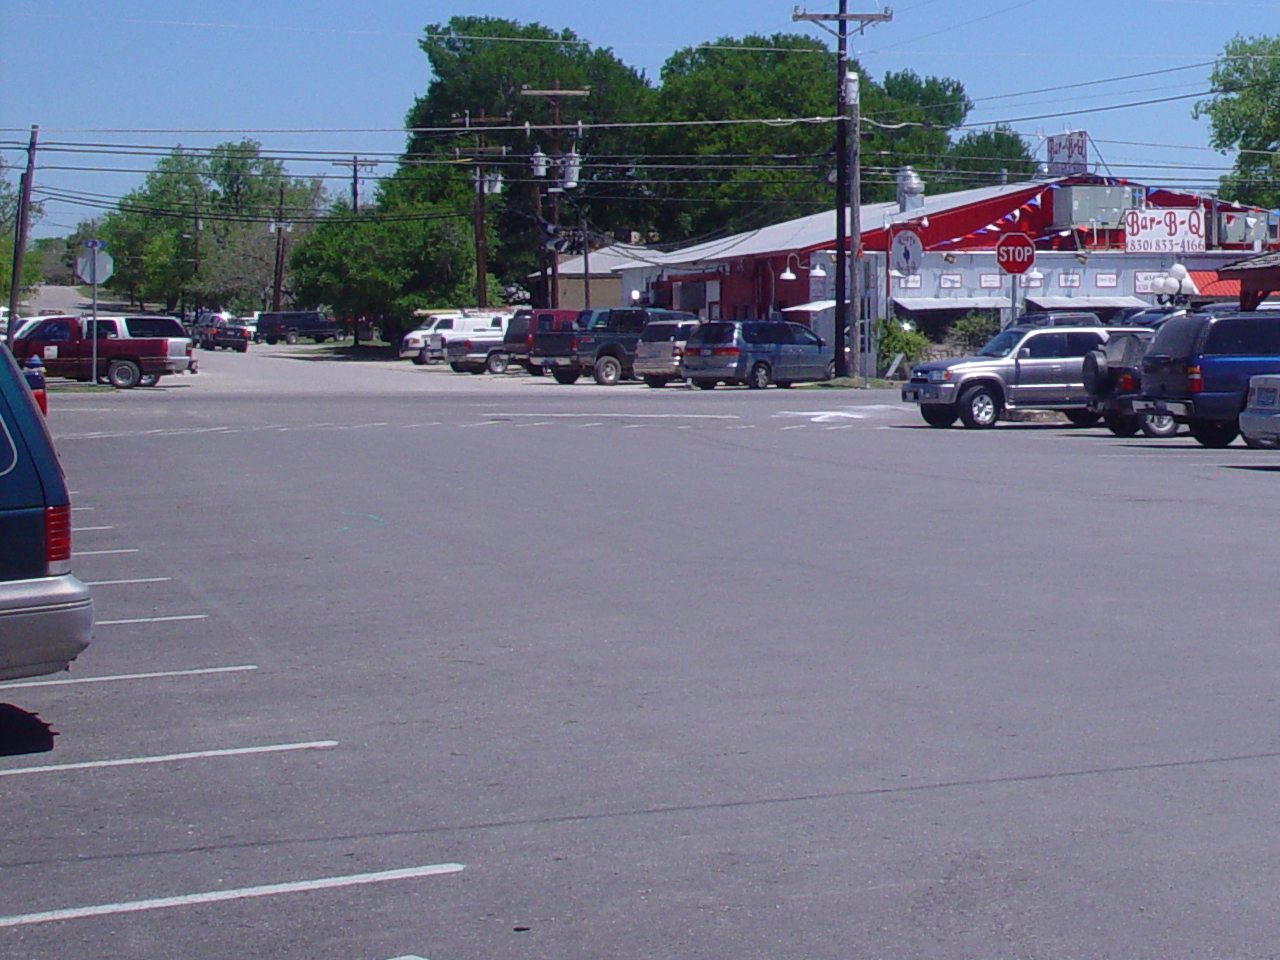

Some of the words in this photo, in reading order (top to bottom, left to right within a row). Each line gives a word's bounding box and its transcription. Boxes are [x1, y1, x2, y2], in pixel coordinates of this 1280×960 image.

[1127, 211, 1205, 238] Bar-B-Q
[999, 246, 1033, 262] STOP
[1155, 239, 1205, 253] 833-4166
